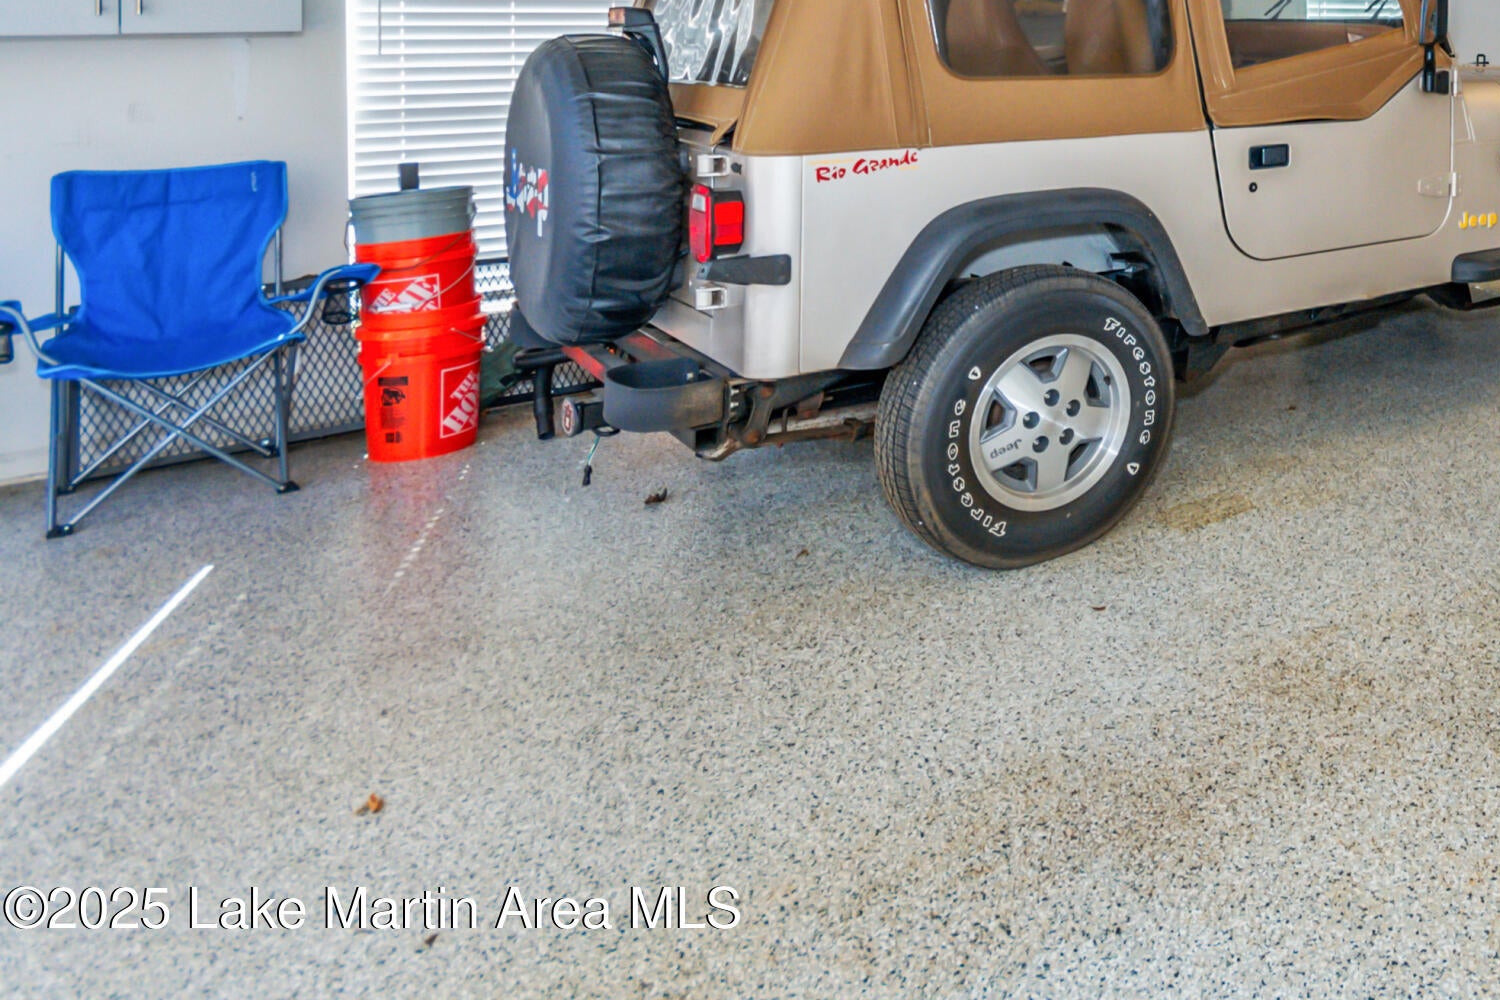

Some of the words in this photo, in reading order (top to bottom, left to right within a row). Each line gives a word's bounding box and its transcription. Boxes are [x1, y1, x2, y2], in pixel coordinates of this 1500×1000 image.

[816, 166, 846, 183] Rio
[852, 149, 918, 175] Grande
[1458, 211, 1498, 230] Jeep
[1103, 316, 1156, 445] Firestone
[989, 438, 1022, 460] Jeep
[947, 399, 1008, 538] Firestone
